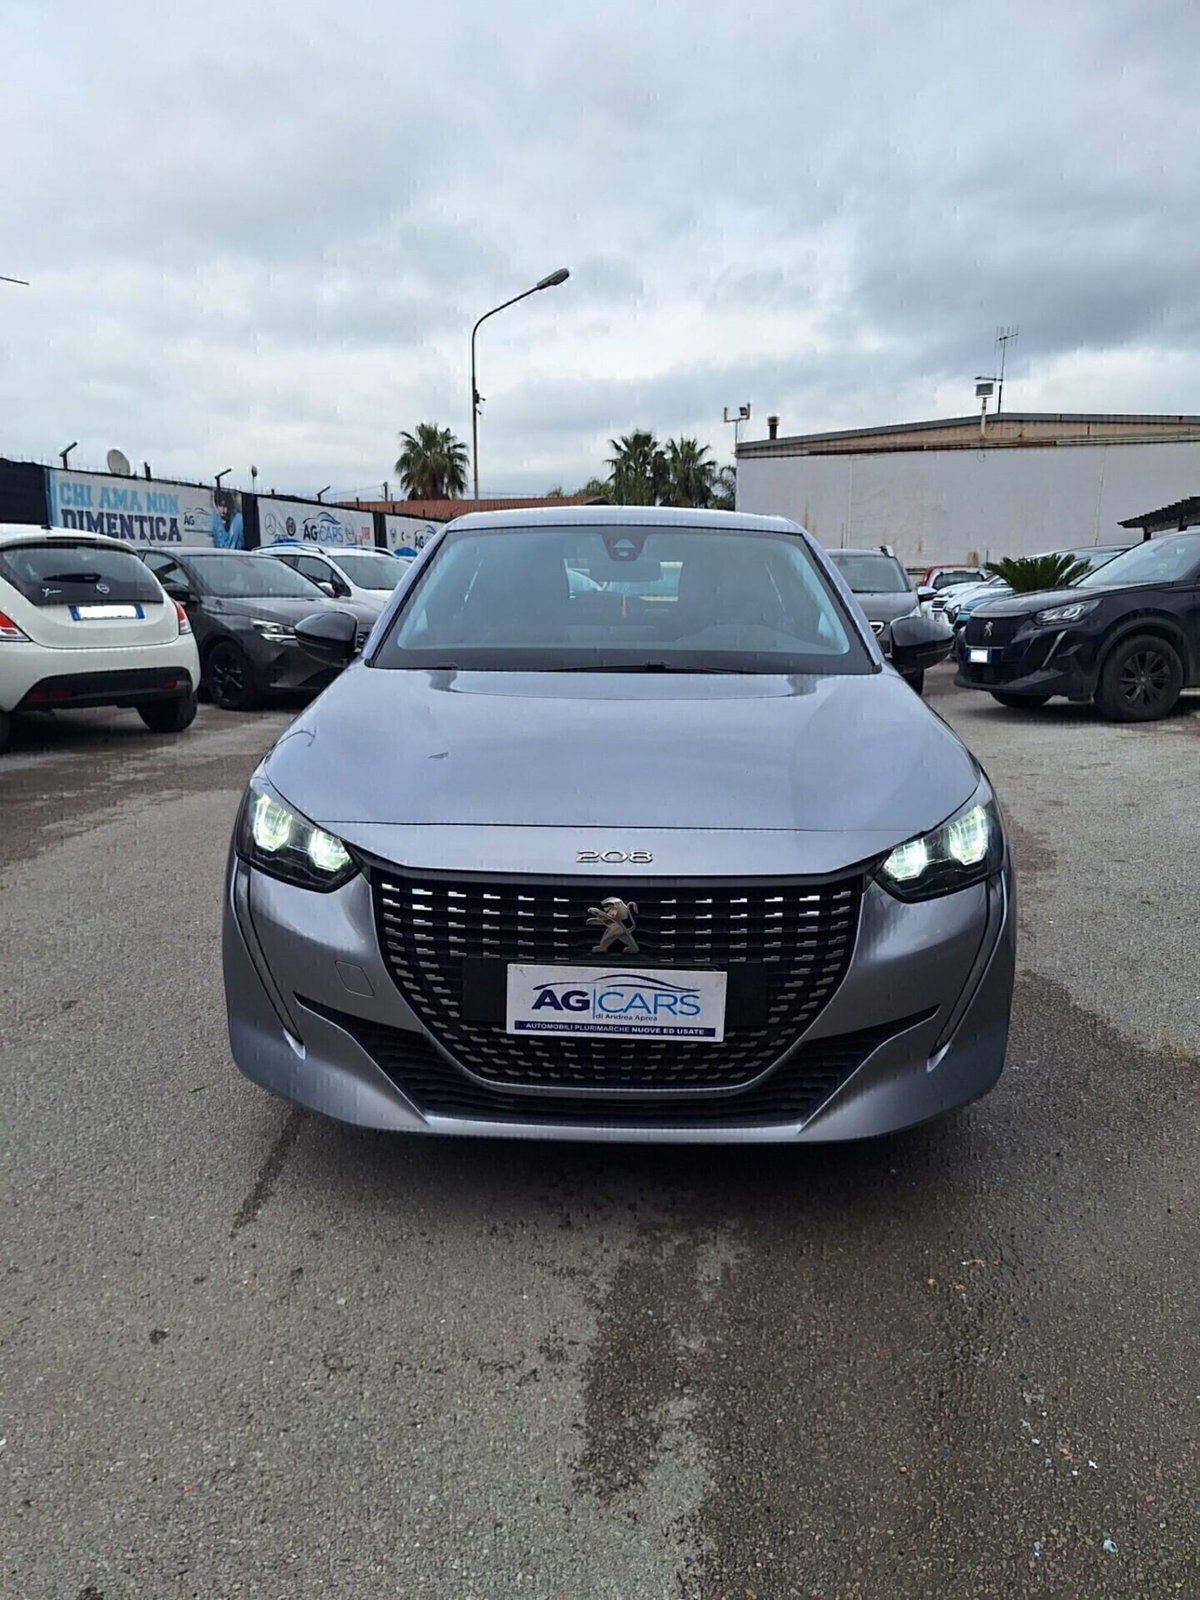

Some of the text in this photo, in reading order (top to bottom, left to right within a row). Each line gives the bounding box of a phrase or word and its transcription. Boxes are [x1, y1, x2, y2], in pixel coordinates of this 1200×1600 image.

[59, 481, 180, 514] CHI AMA NON
[61, 509, 182, 542] DIMENTICA
[303, 524, 318, 541] AG
[319, 525, 344, 543] CARS
[576, 849, 653, 864] 208
[531, 989, 702, 1017] AG CARS
[605, 1013, 633, 1021] Andrea
[635, 1014, 658, 1023] Aprea
[525, 1022, 705, 1036] AUTOMOBILI PLURIMARCHE NUOVE ED USATE
